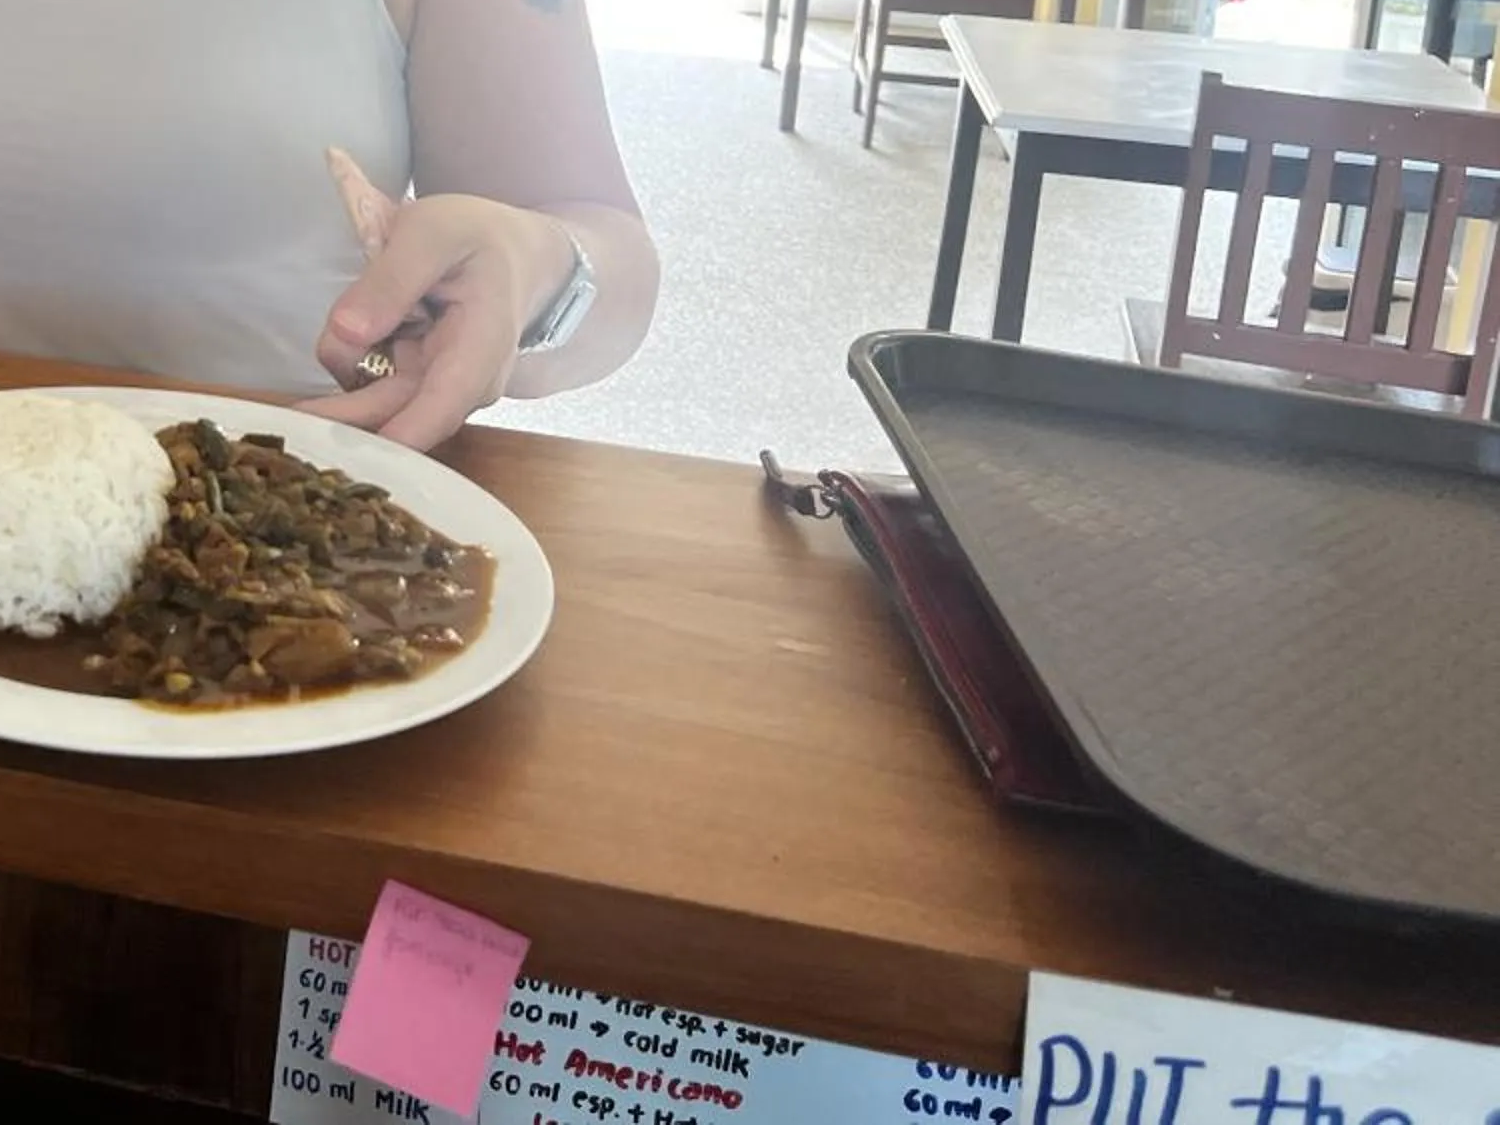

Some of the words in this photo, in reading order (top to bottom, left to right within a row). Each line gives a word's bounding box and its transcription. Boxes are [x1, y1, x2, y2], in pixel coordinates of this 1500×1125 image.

[308, 936, 357, 967] HOT
[299, 968, 327, 992] 60
[330, 980, 349, 997] m
[298, 996, 311, 1019] 1
[509, 1000, 544, 1024] 00
[547, 1009, 579, 1031] ml
[622, 1029, 679, 1059] cold
[690, 1048, 751, 1080] milk
[735, 1025, 806, 1058] sugar
[489, 1070, 522, 1096] 60
[529, 1081, 561, 1103] ml
[493, 1030, 546, 1066] Hot
[563, 1047, 744, 1111] Americano
[281, 1066, 321, 1094] 100
[329, 1080, 357, 1105] ml
[375, 1089, 432, 1125] Milk
[903, 1088, 938, 1115] 60
